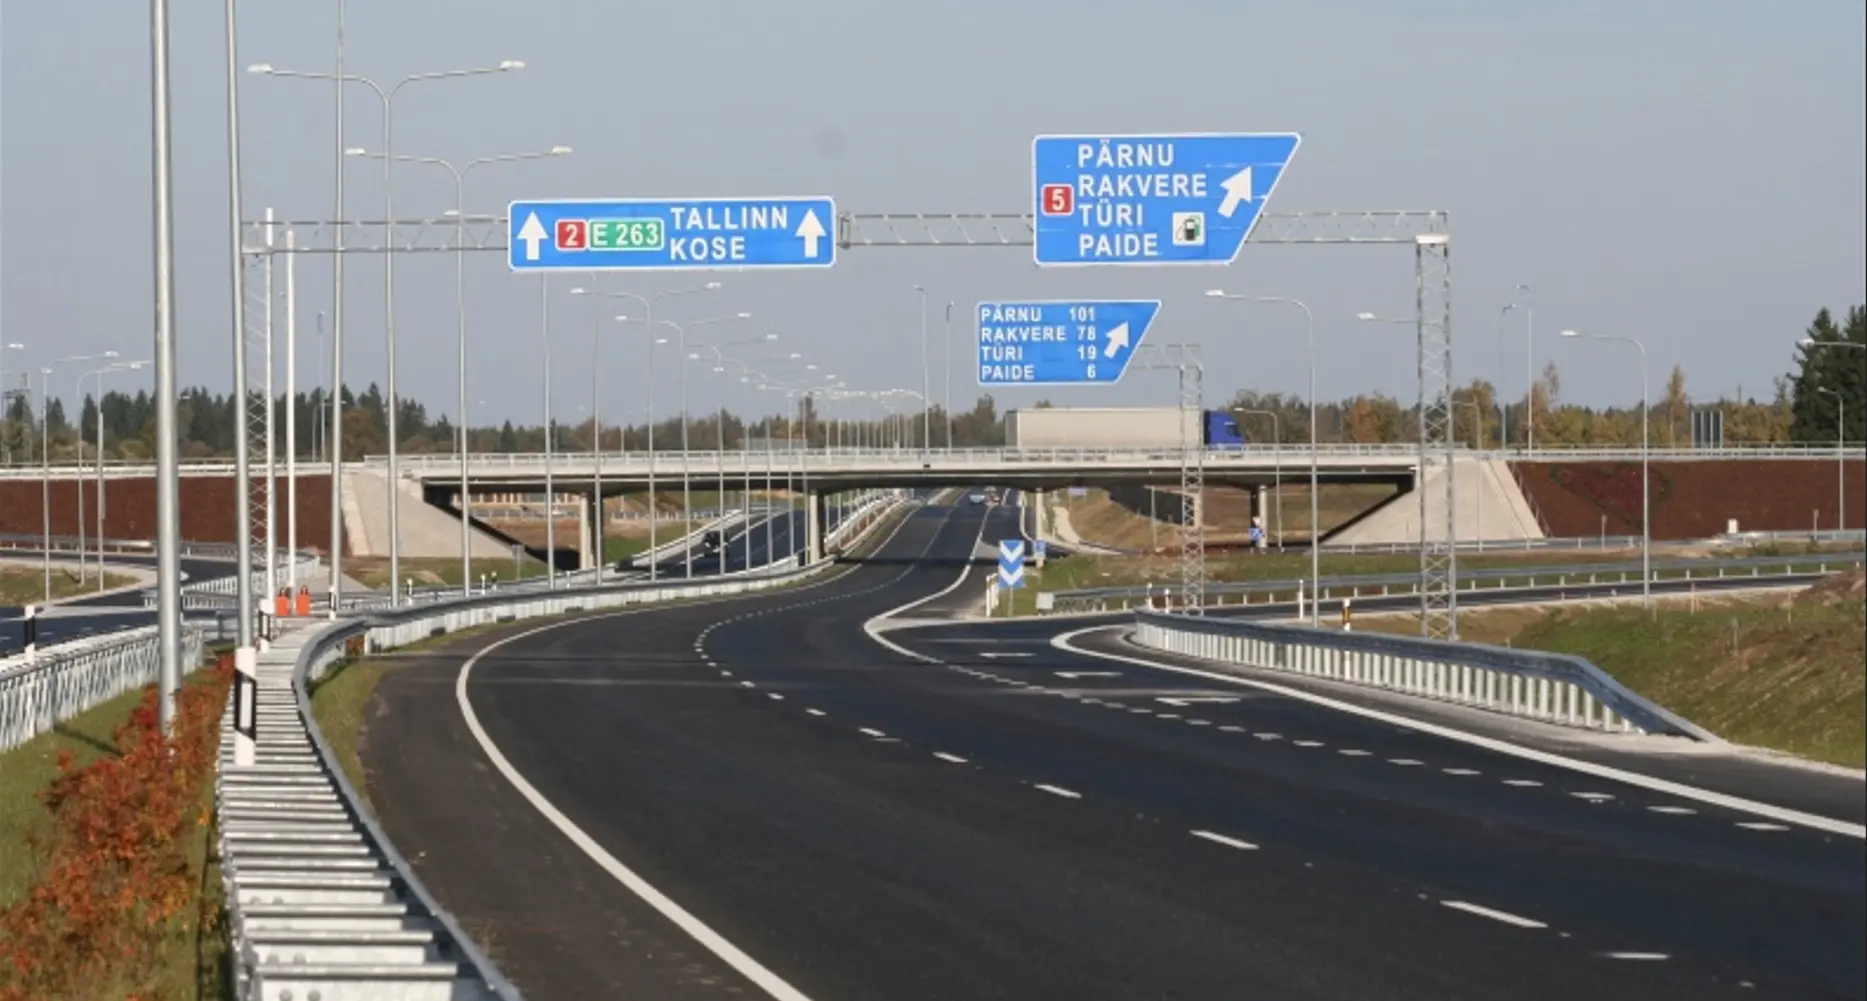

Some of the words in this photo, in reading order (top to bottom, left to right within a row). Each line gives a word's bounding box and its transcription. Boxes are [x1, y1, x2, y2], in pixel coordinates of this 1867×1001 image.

[1077, 139, 1174, 168] PÄRNU
[1078, 173, 1208, 197] RAKVERE
[1052, 188, 1066, 211] 5
[670, 207, 788, 230] TALLINN
[1078, 199, 1143, 227] TÜRI
[565, 222, 579, 247] 2
[593, 224, 608, 246] E
[616, 222, 659, 246] 263
[1079, 233, 1158, 257] PAIDE
[670, 237, 746, 261] KOSE
[1069, 306, 1096, 322] 101
[981, 326, 1067, 343] RAKVERE
[1076, 326, 1097, 341] 78
[1077, 345, 1097, 361] 19
[981, 365, 1035, 380] PAIDE
[1087, 364, 1096, 379] 6
